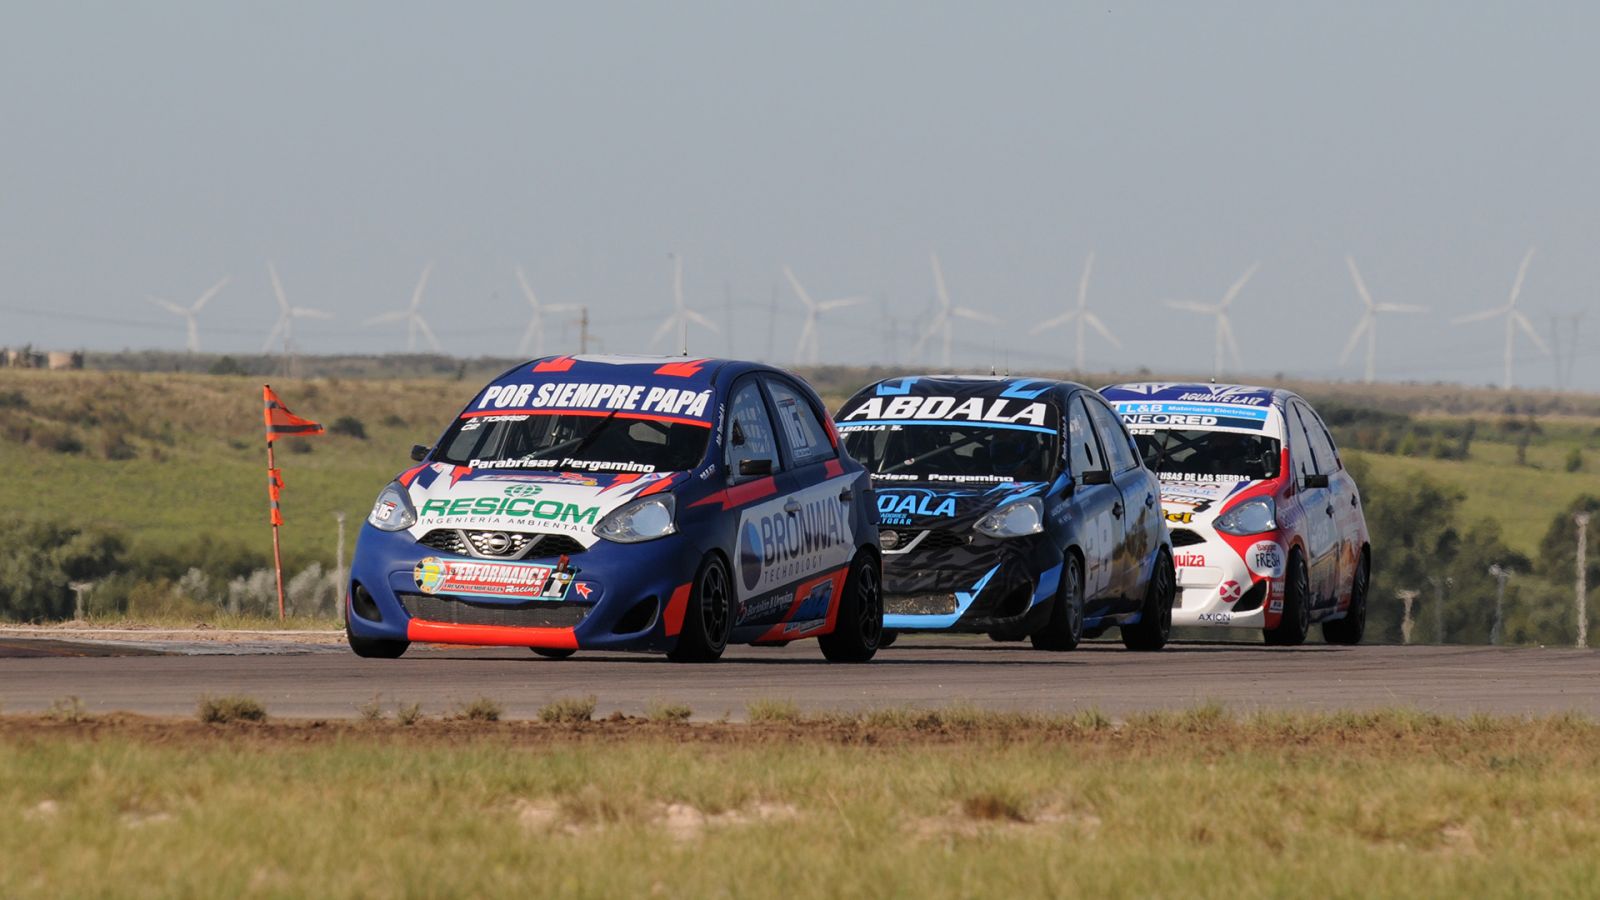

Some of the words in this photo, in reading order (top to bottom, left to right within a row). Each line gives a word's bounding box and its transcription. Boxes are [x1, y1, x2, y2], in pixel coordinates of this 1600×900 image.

[478, 384, 534, 409] POR
[532, 383, 646, 410] SIEMPRE
[641, 387, 713, 417] PAPÁ
[1178, 392, 1230, 403] AGUANTE
[843, 396, 1046, 426] ABDALA
[1126, 403, 1162, 413] L&B
[1168, 405, 1213, 413] Materiales
[1122, 414, 1217, 426] NEORED
[468, 458, 558, 469] Parabrisas
[560, 458, 655, 473] Pergamino
[928, 474, 1014, 482] Pergamino
[1184, 473, 1195, 481] DE
[1197, 473, 1214, 481] LAS
[421, 497, 601, 525] RESICOM
[421, 517, 501, 526] INGENIERÍA
[509, 519, 587, 533] AMBIENTAL
[761, 495, 845, 567] BRONWAY
[1256, 552, 1281, 568] FRESH
[446, 561, 549, 583] PERFORMANCE
[765, 555, 822, 584] TECHNOLOGY
[505, 585, 541, 595] Racing
[1198, 613, 1231, 621] AXION
